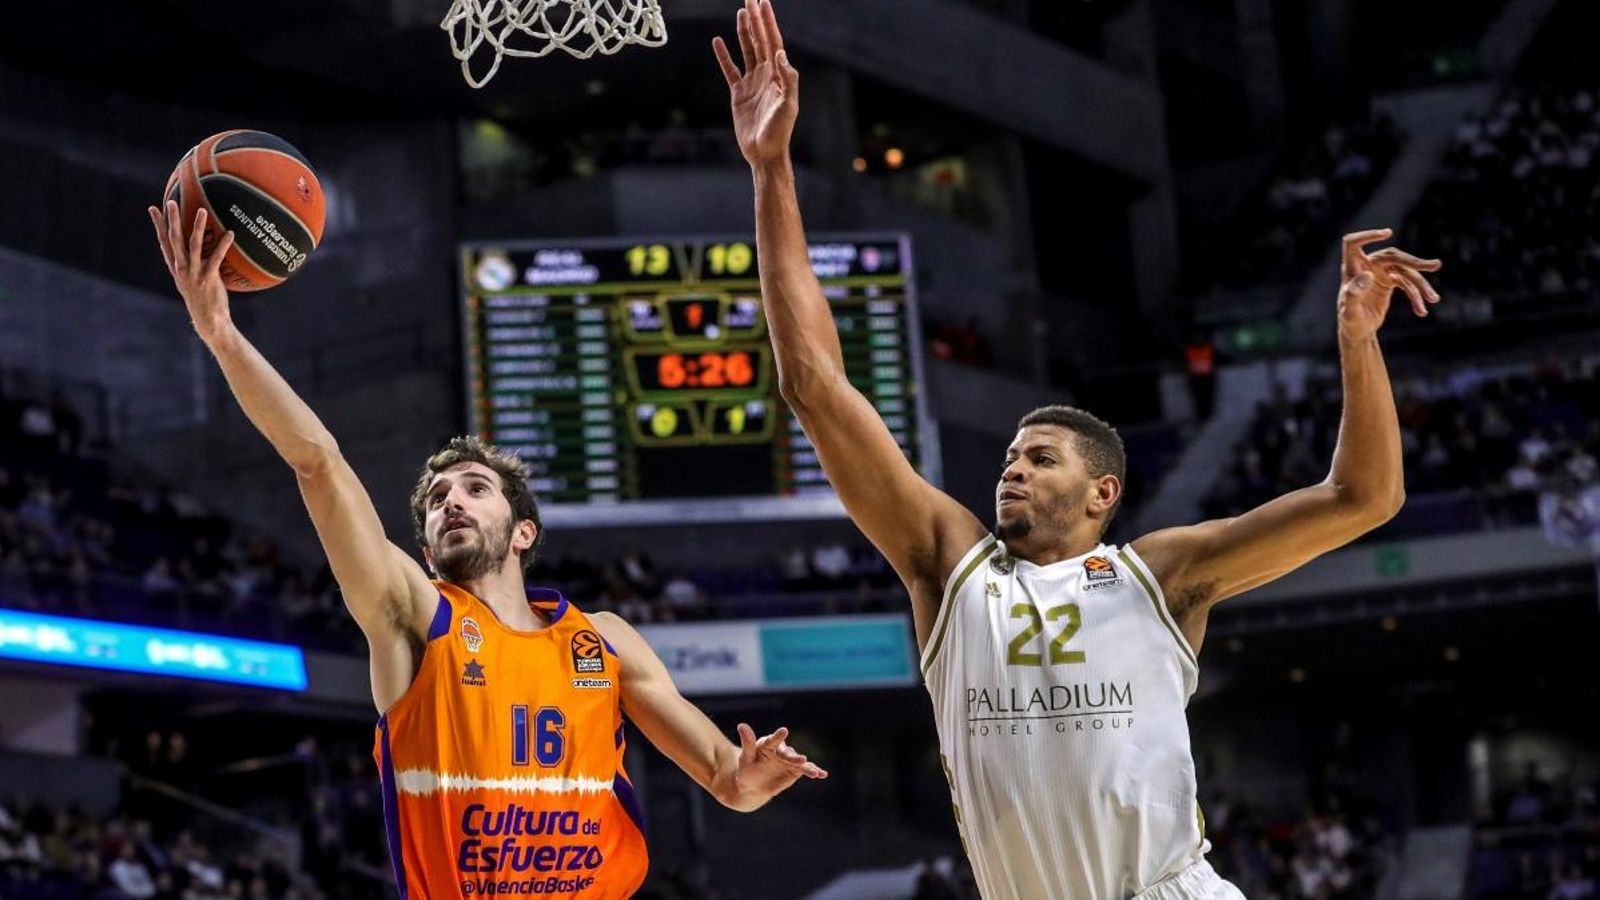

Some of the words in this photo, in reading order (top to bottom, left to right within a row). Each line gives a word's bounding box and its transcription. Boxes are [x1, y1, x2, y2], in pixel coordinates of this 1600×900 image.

[627, 244, 670, 275] 13
[708, 242, 752, 274] 10
[1006, 602, 1086, 667] 22
[967, 681, 1133, 713] PALLADIUM
[511, 704, 566, 768] 16
[968, 724, 1034, 737] HOTEL
[1056, 718, 1135, 733] GROUP
[461, 804, 579, 836] Cultura
[458, 838, 603, 873] Esfuerzo
